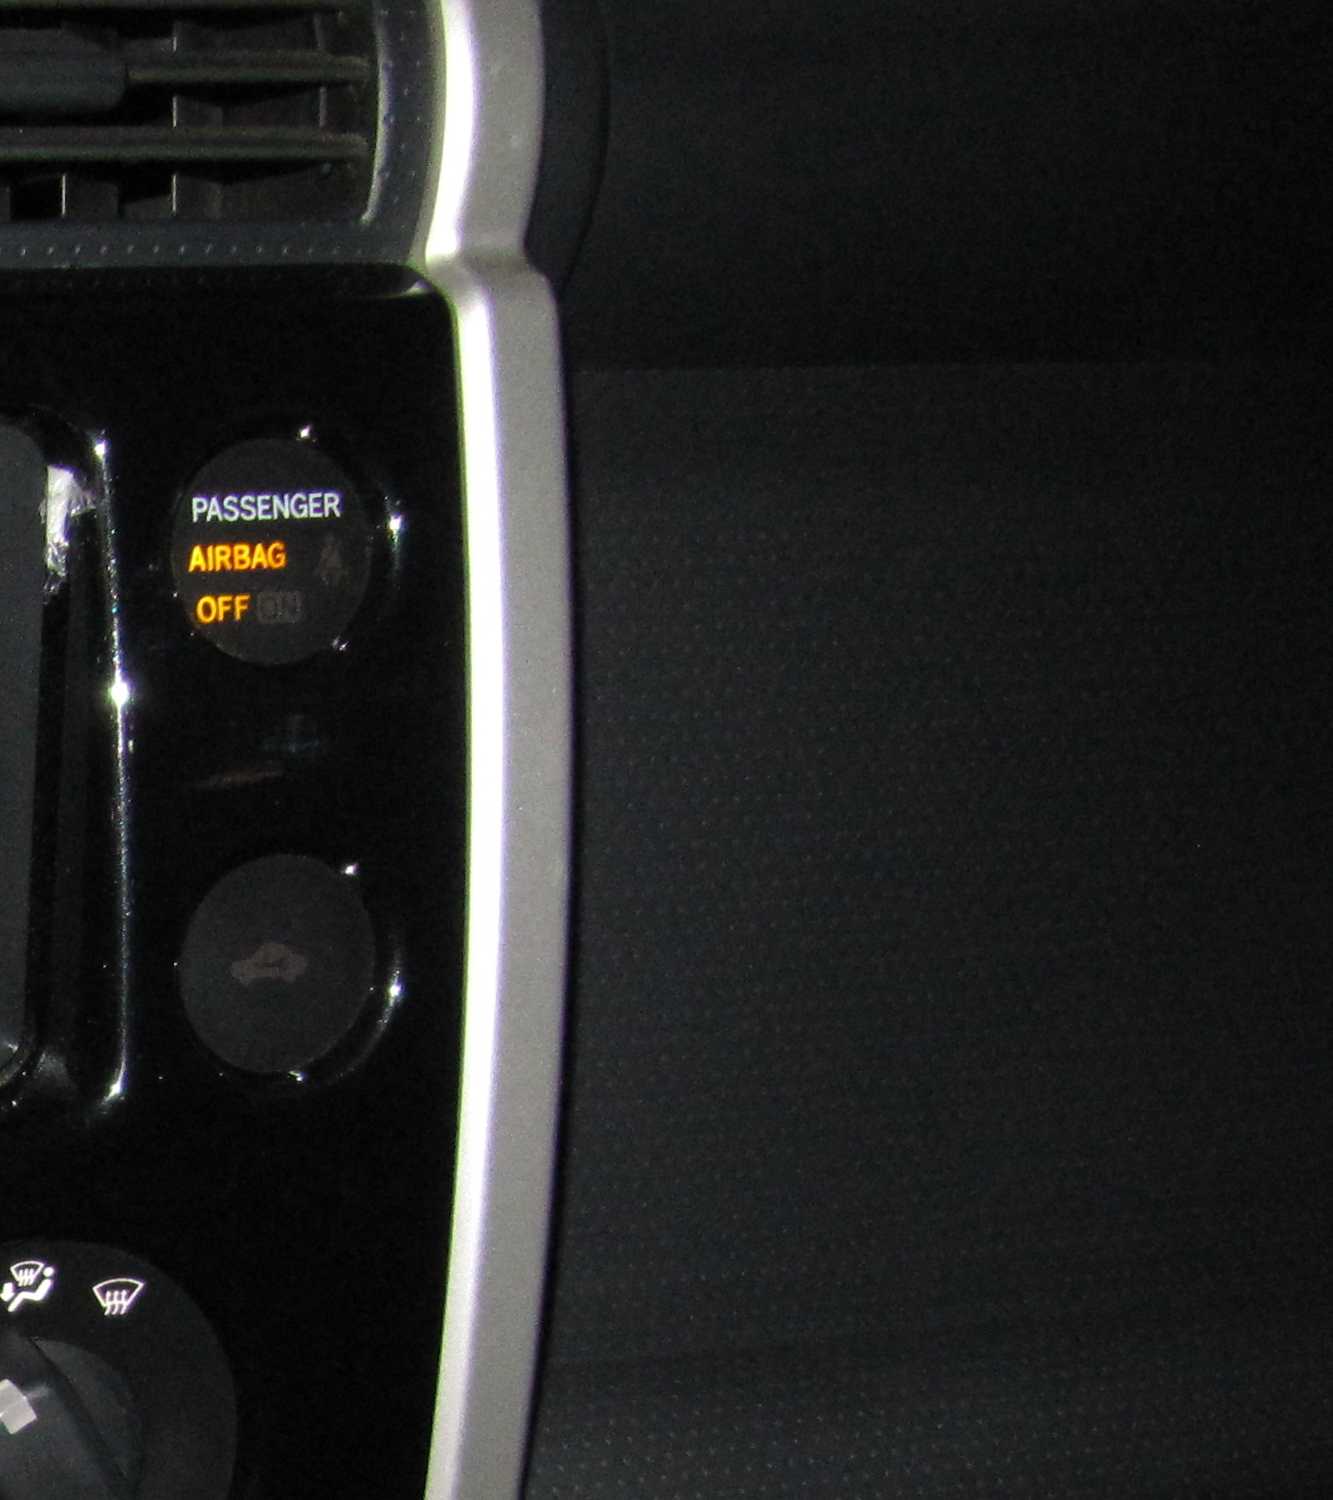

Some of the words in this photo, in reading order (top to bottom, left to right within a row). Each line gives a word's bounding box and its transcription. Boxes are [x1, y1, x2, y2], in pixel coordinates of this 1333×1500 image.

[191, 491, 341, 523] PASSENGER
[188, 541, 287, 573] AIRBAG
[196, 594, 252, 624] OFF
